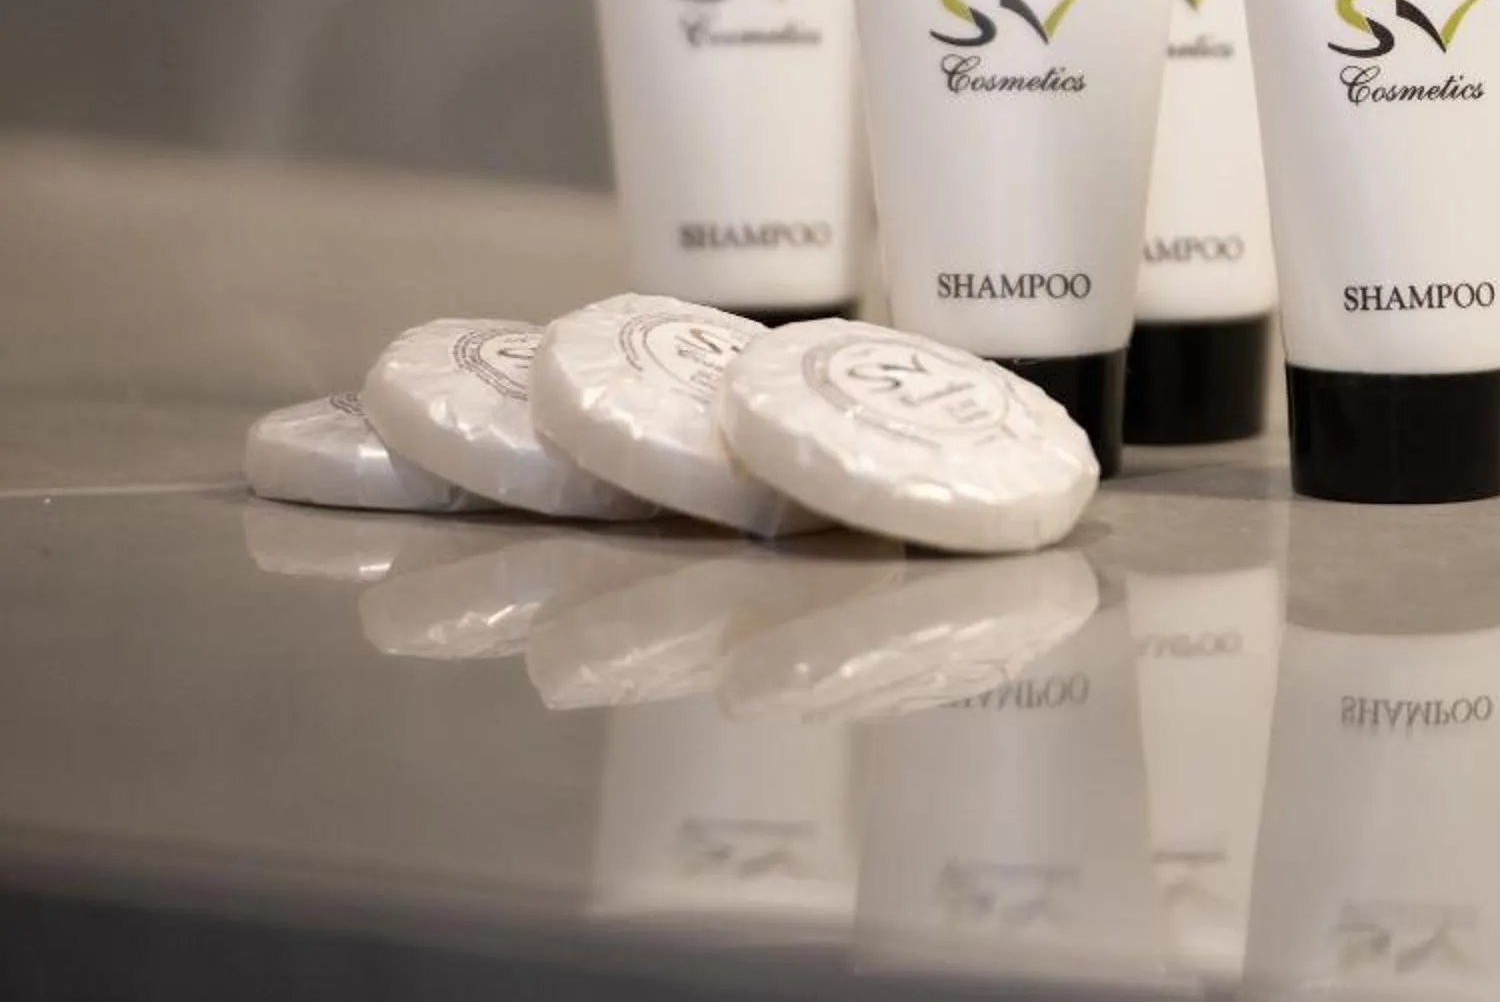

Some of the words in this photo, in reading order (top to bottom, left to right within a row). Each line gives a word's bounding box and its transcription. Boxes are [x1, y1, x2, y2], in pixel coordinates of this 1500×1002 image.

[940, 55, 1087, 94] Cosmetics
[1339, 65, 1486, 106] Cosmetics
[937, 273, 1092, 299] SHAMPOO
[1343, 281, 1496, 313] SHAMPOO
